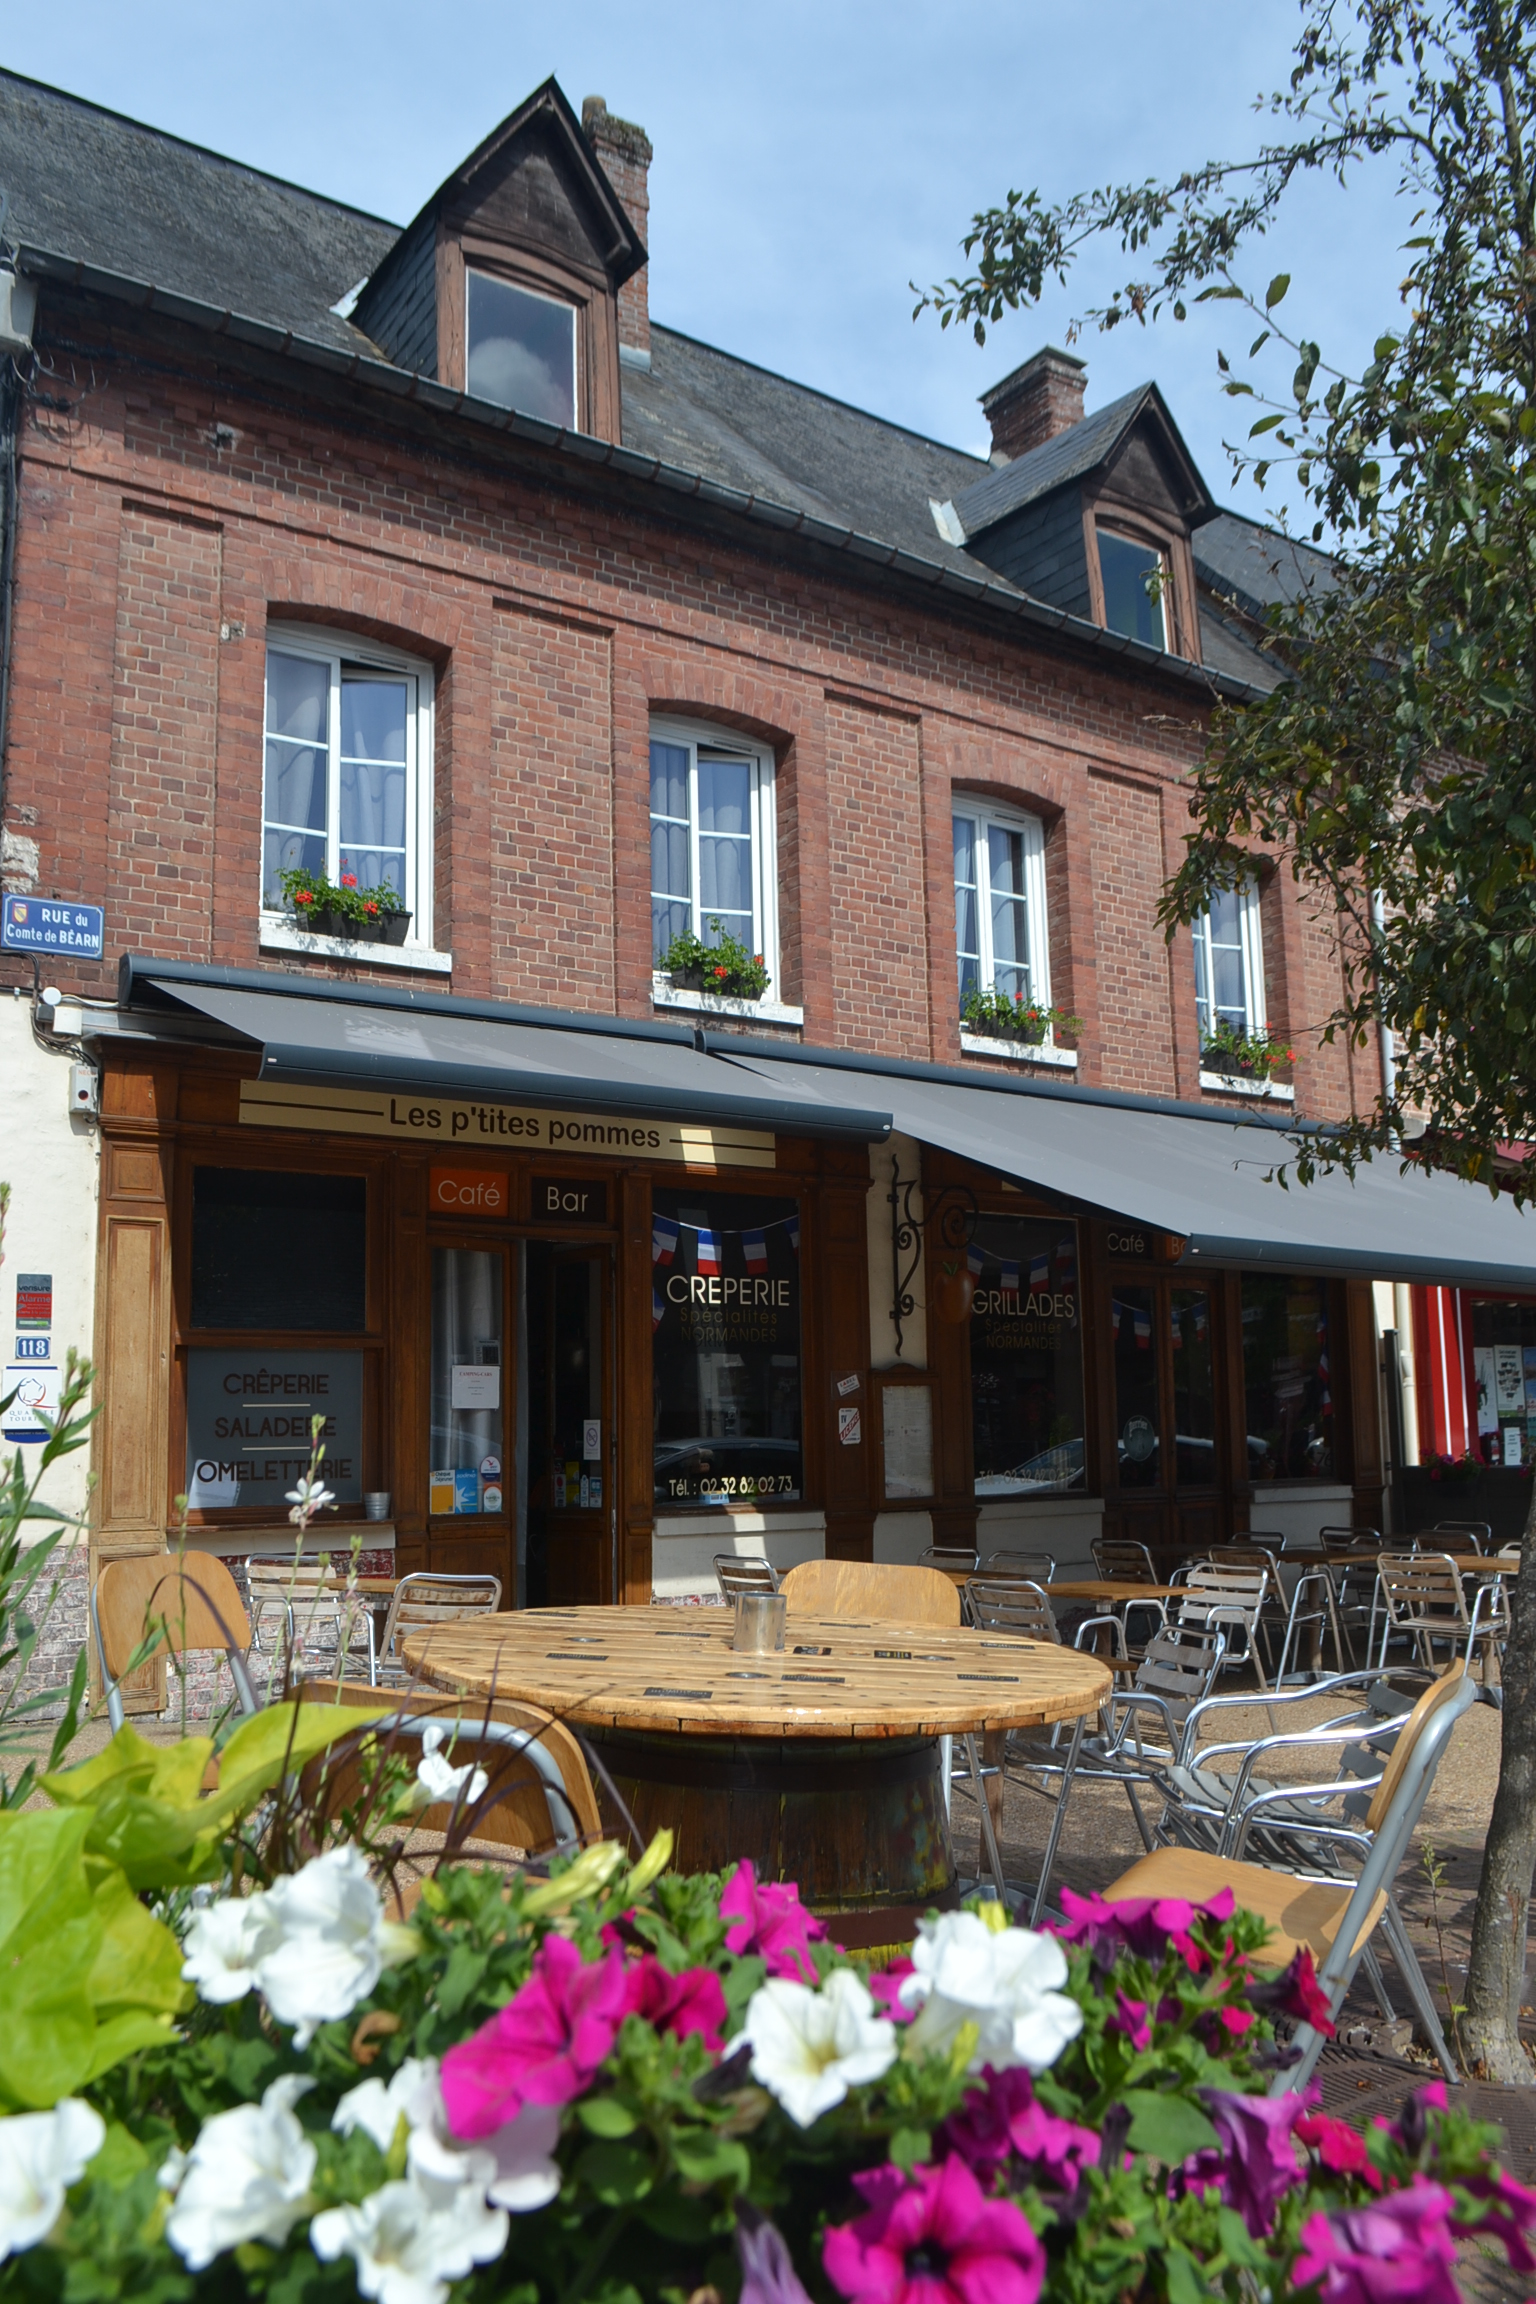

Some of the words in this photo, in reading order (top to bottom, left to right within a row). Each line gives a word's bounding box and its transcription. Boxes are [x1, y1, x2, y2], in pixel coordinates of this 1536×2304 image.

[41, 908, 71, 925] RUE
[75, 913, 88, 927] du
[6, 923, 43, 941] Comte
[44, 929, 57, 943] de
[59, 929, 99, 948] BÉARN
[389, 1098, 441, 1127] Les
[451, 1105, 540, 1137] p'tites
[548, 1120, 661, 1149] pommes
[437, 1179, 501, 1207] Café
[546, 1186, 589, 1213] Bar
[1107, 1232, 1145, 1253] Café
[18, 1294, 51, 1303] Alarme
[666, 1275, 790, 1306] CREPERIE
[972, 1290, 1075, 1318] GRILLADES
[680, 1307, 777, 1325] Spécialités
[985, 1318, 1062, 1334] Spécialités
[681, 1326, 777, 1343] NORMANDES
[986, 1335, 1061, 1351] NORMANDES
[21, 1340, 46, 1356] 118
[223, 1368, 330, 1395] CRÊPERIE
[196, 1459, 353, 1483] OMELETTERIE
[669, 1479, 690, 1496] Tél.
[700, 1478, 718, 1494] 02
[721, 1477, 736, 1494] 32
[739, 1476, 755, 1493] 82
[758, 1475, 775, 1492] 02
[778, 1475, 793, 1492] 73
